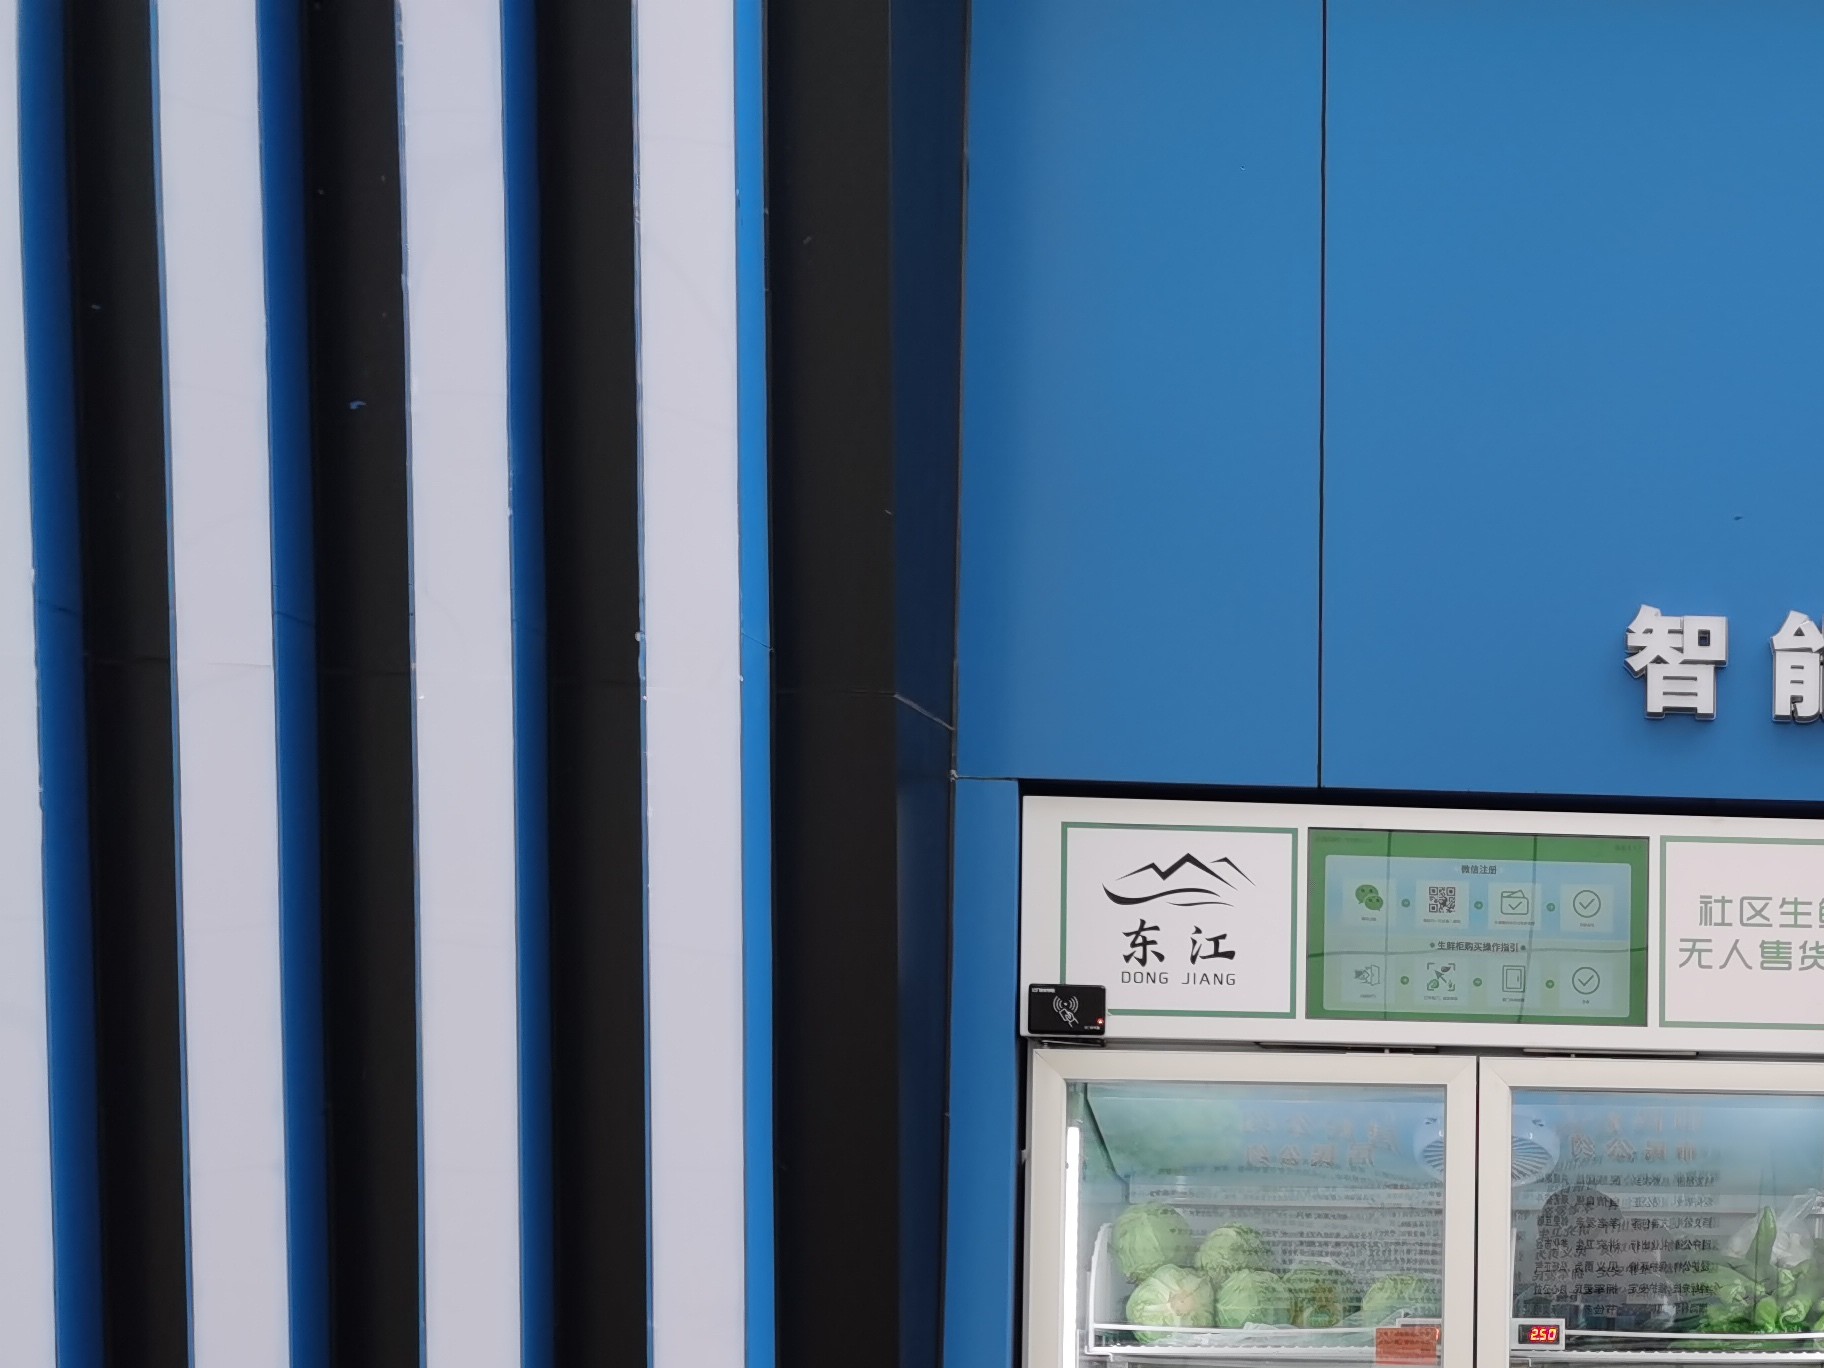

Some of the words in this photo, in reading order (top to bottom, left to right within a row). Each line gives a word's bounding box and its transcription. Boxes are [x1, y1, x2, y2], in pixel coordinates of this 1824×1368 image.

[1461, 864, 1497, 875] 微信注册
[1121, 918, 1237, 967] 东江
[1437, 941, 1519, 953] 生鲜柜购买操作指引
[1121, 970, 1169, 985] DONG
[1181, 972, 1237, 987] JIANG
[1530, 1328, 1557, 1341] 2.50
